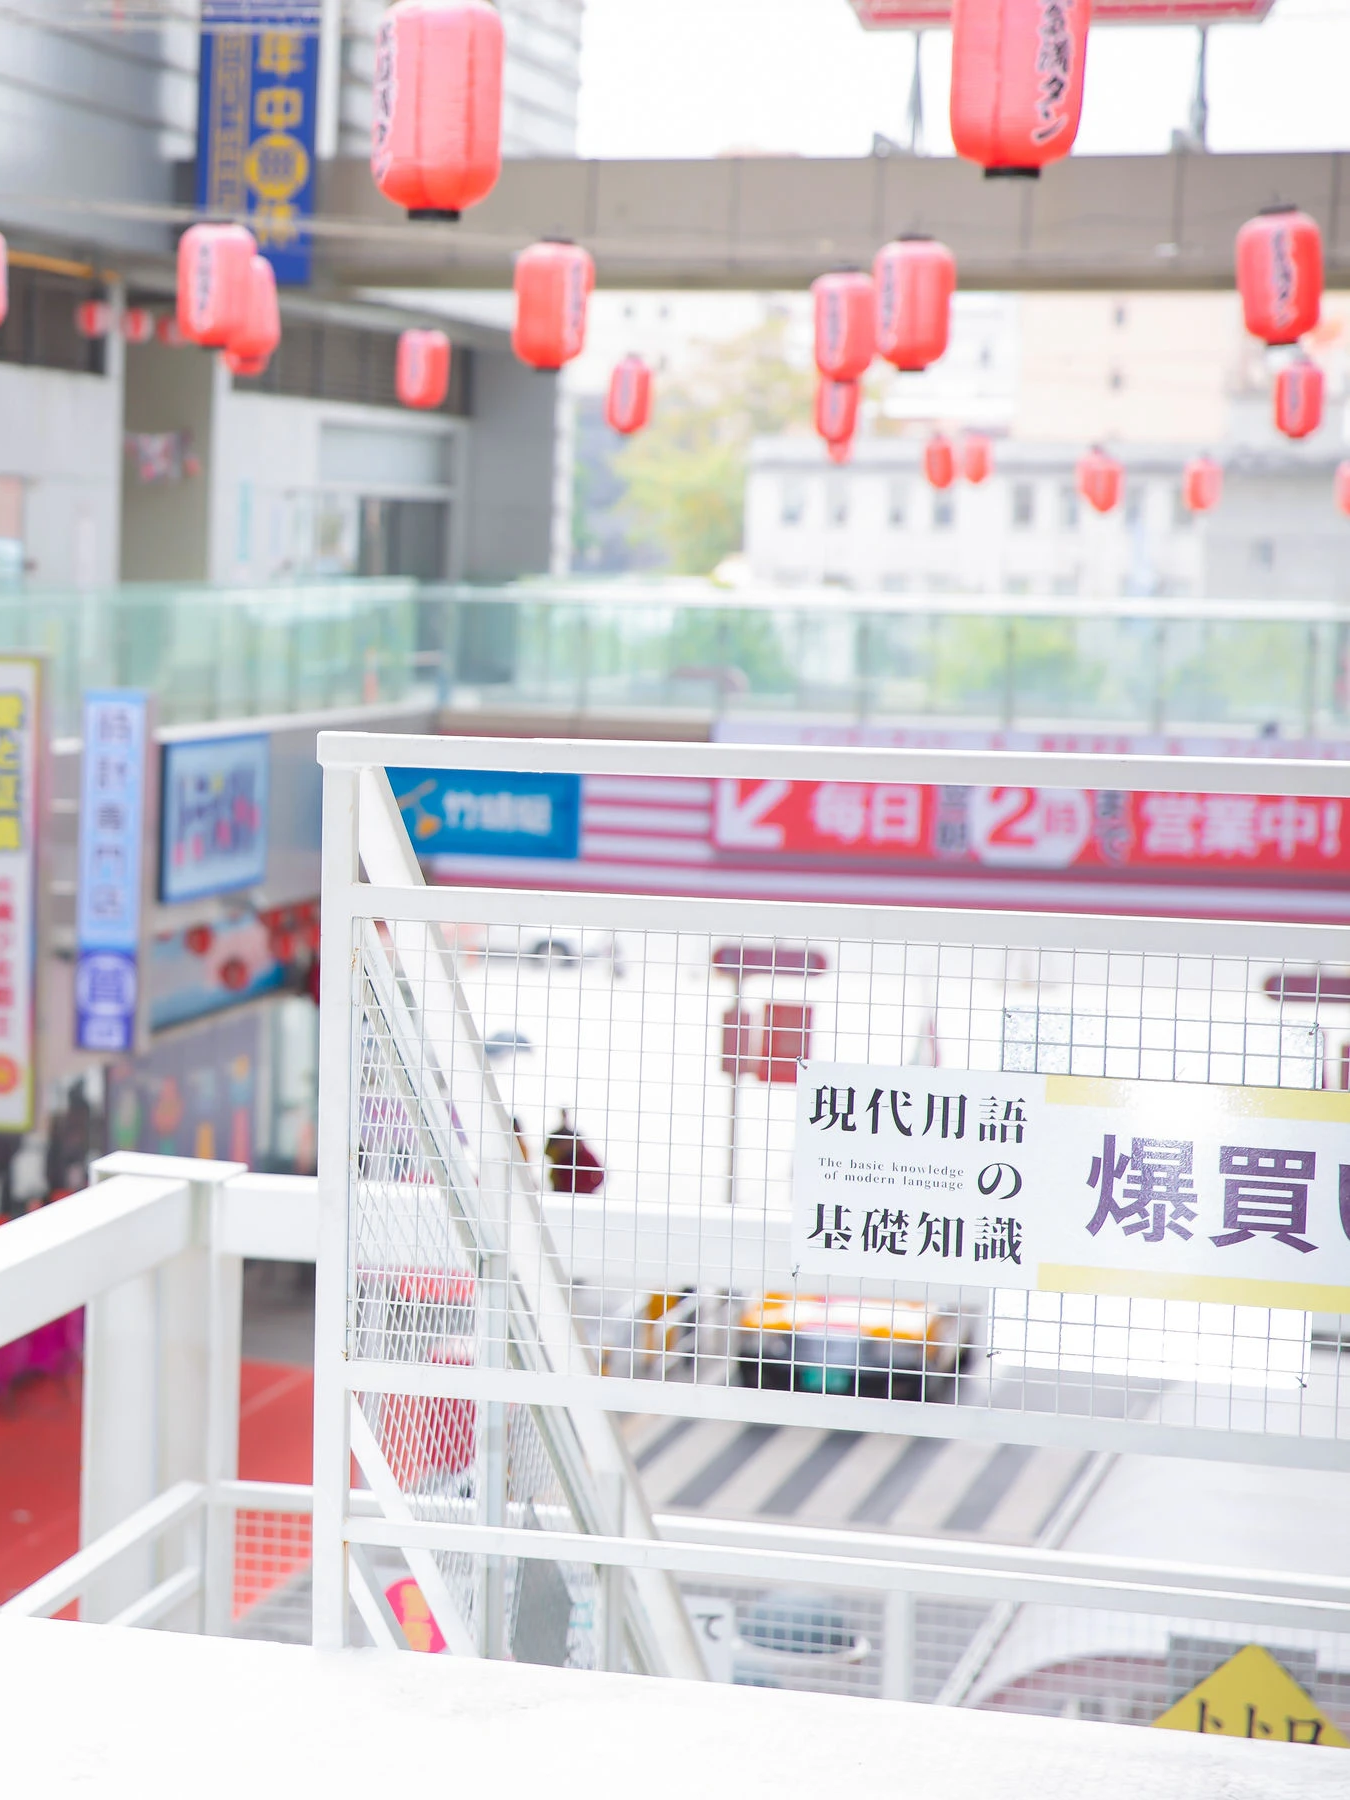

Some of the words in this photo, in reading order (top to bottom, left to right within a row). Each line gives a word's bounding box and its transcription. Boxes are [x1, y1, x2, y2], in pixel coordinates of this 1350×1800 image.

[808, 1084, 1028, 1143] 現代用語
[818, 1156, 843, 1169] The
[850, 1158, 885, 1172] basic
[892, 1161, 965, 1179] knowledge
[824, 1170, 838, 1181] of
[844, 1172, 896, 1185] modern
[903, 1175, 965, 1192] language
[977, 1162, 1023, 1200] の
[806, 1203, 1024, 1266] 基礎知識
